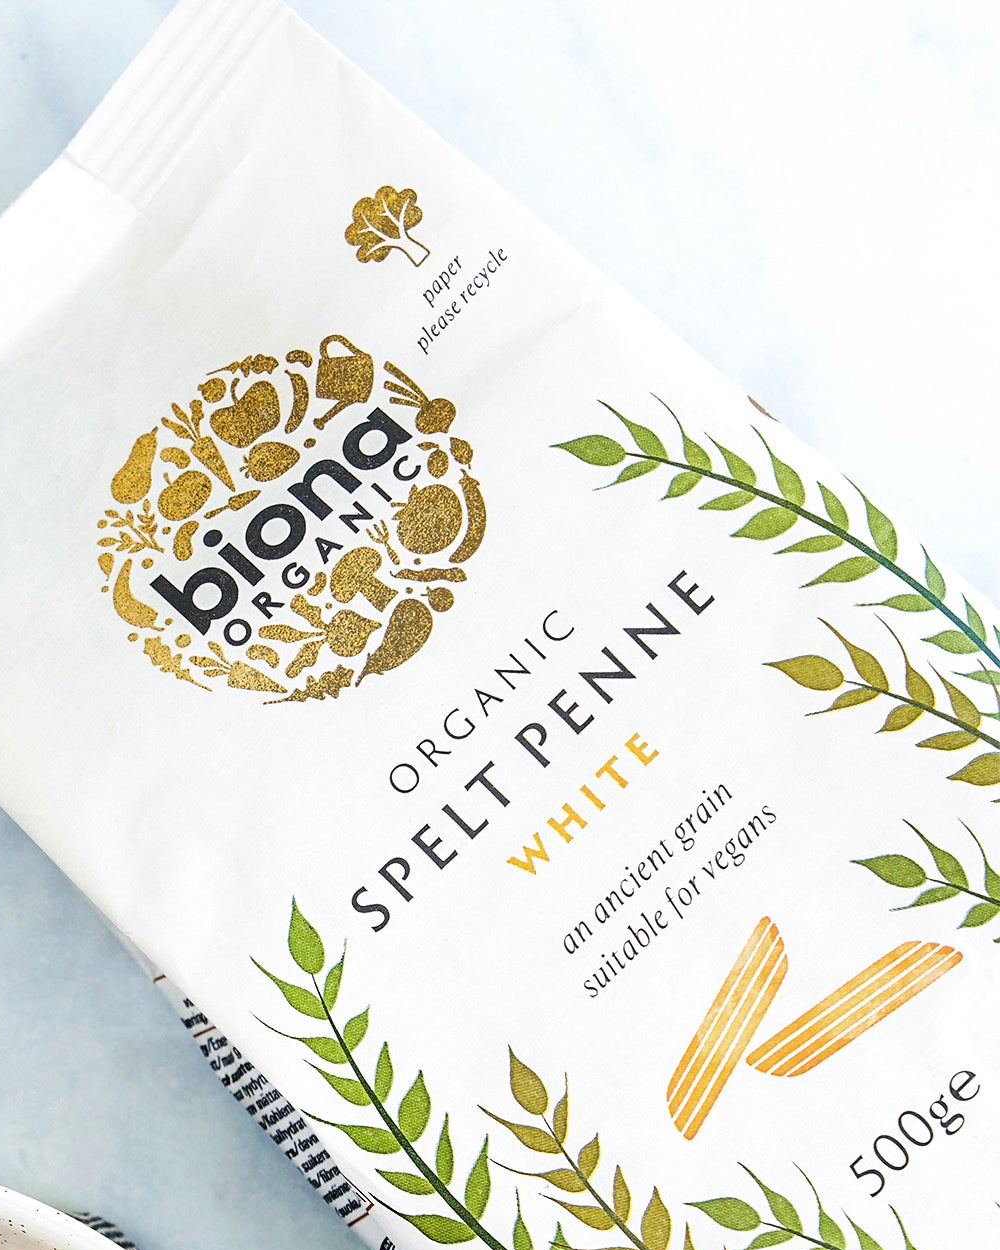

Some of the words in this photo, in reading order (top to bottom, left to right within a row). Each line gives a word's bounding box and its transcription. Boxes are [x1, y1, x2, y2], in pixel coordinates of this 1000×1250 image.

[417, 301, 462, 355] please
[460, 248, 508, 304] recycle
[422, 255, 462, 309] paper
[149, 407, 414, 637] biona
[222, 454, 422, 646] ORGANIC
[351, 761, 511, 933] SPELT
[514, 570, 716, 769] PENNE
[389, 609, 575, 794] ORGANIC
[506, 731, 660, 876] WHITE
[563, 920, 594, 955] an
[594, 838, 675, 925] ancient
[674, 783, 734, 852] grain
[583, 910, 669, 998] suitable
[664, 876, 701, 920] for
[702, 805, 778, 880] vegans
